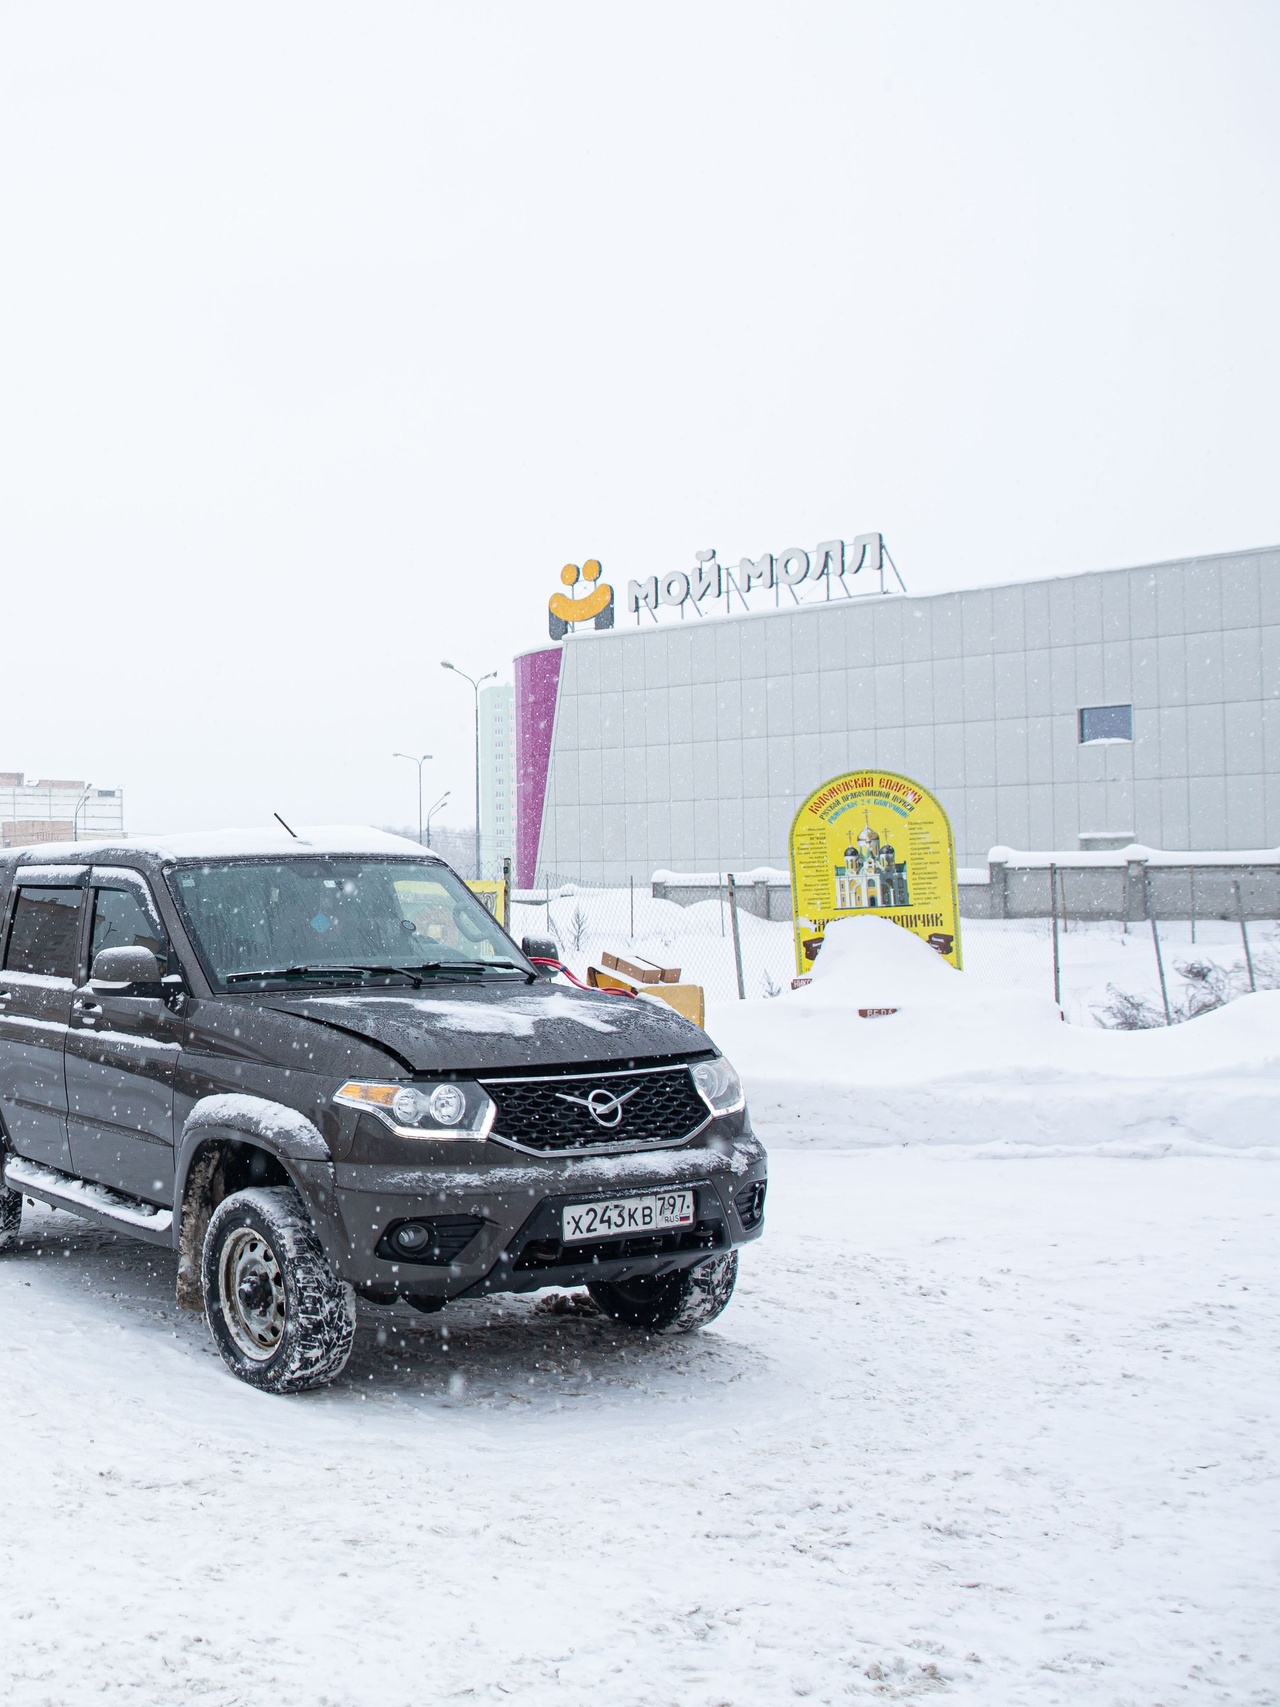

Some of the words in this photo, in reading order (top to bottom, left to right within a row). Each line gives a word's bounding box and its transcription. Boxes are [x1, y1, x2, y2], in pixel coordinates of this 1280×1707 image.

[628, 549, 721, 613] МОЙ
[740, 532, 884, 593] МОЛЛ
[657, 1195, 687, 1216] 797
[664, 1214, 680, 1223] RUS
